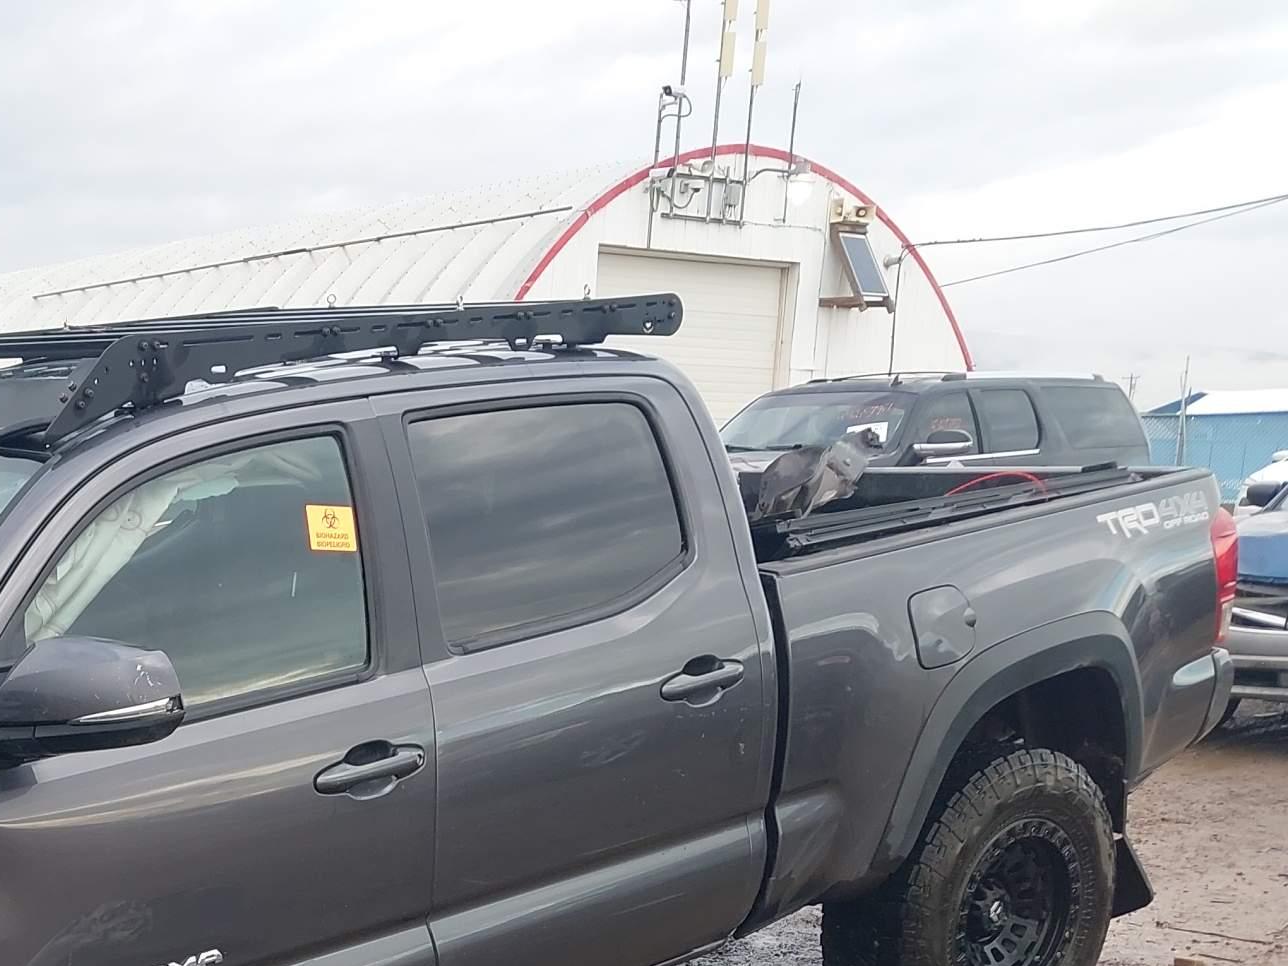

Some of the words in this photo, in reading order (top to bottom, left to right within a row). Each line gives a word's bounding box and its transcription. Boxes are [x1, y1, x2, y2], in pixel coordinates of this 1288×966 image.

[1096, 502, 1160, 538] TRD
[1163, 517, 1182, 529] OFF
[1183, 511, 1209, 524] ROAD
